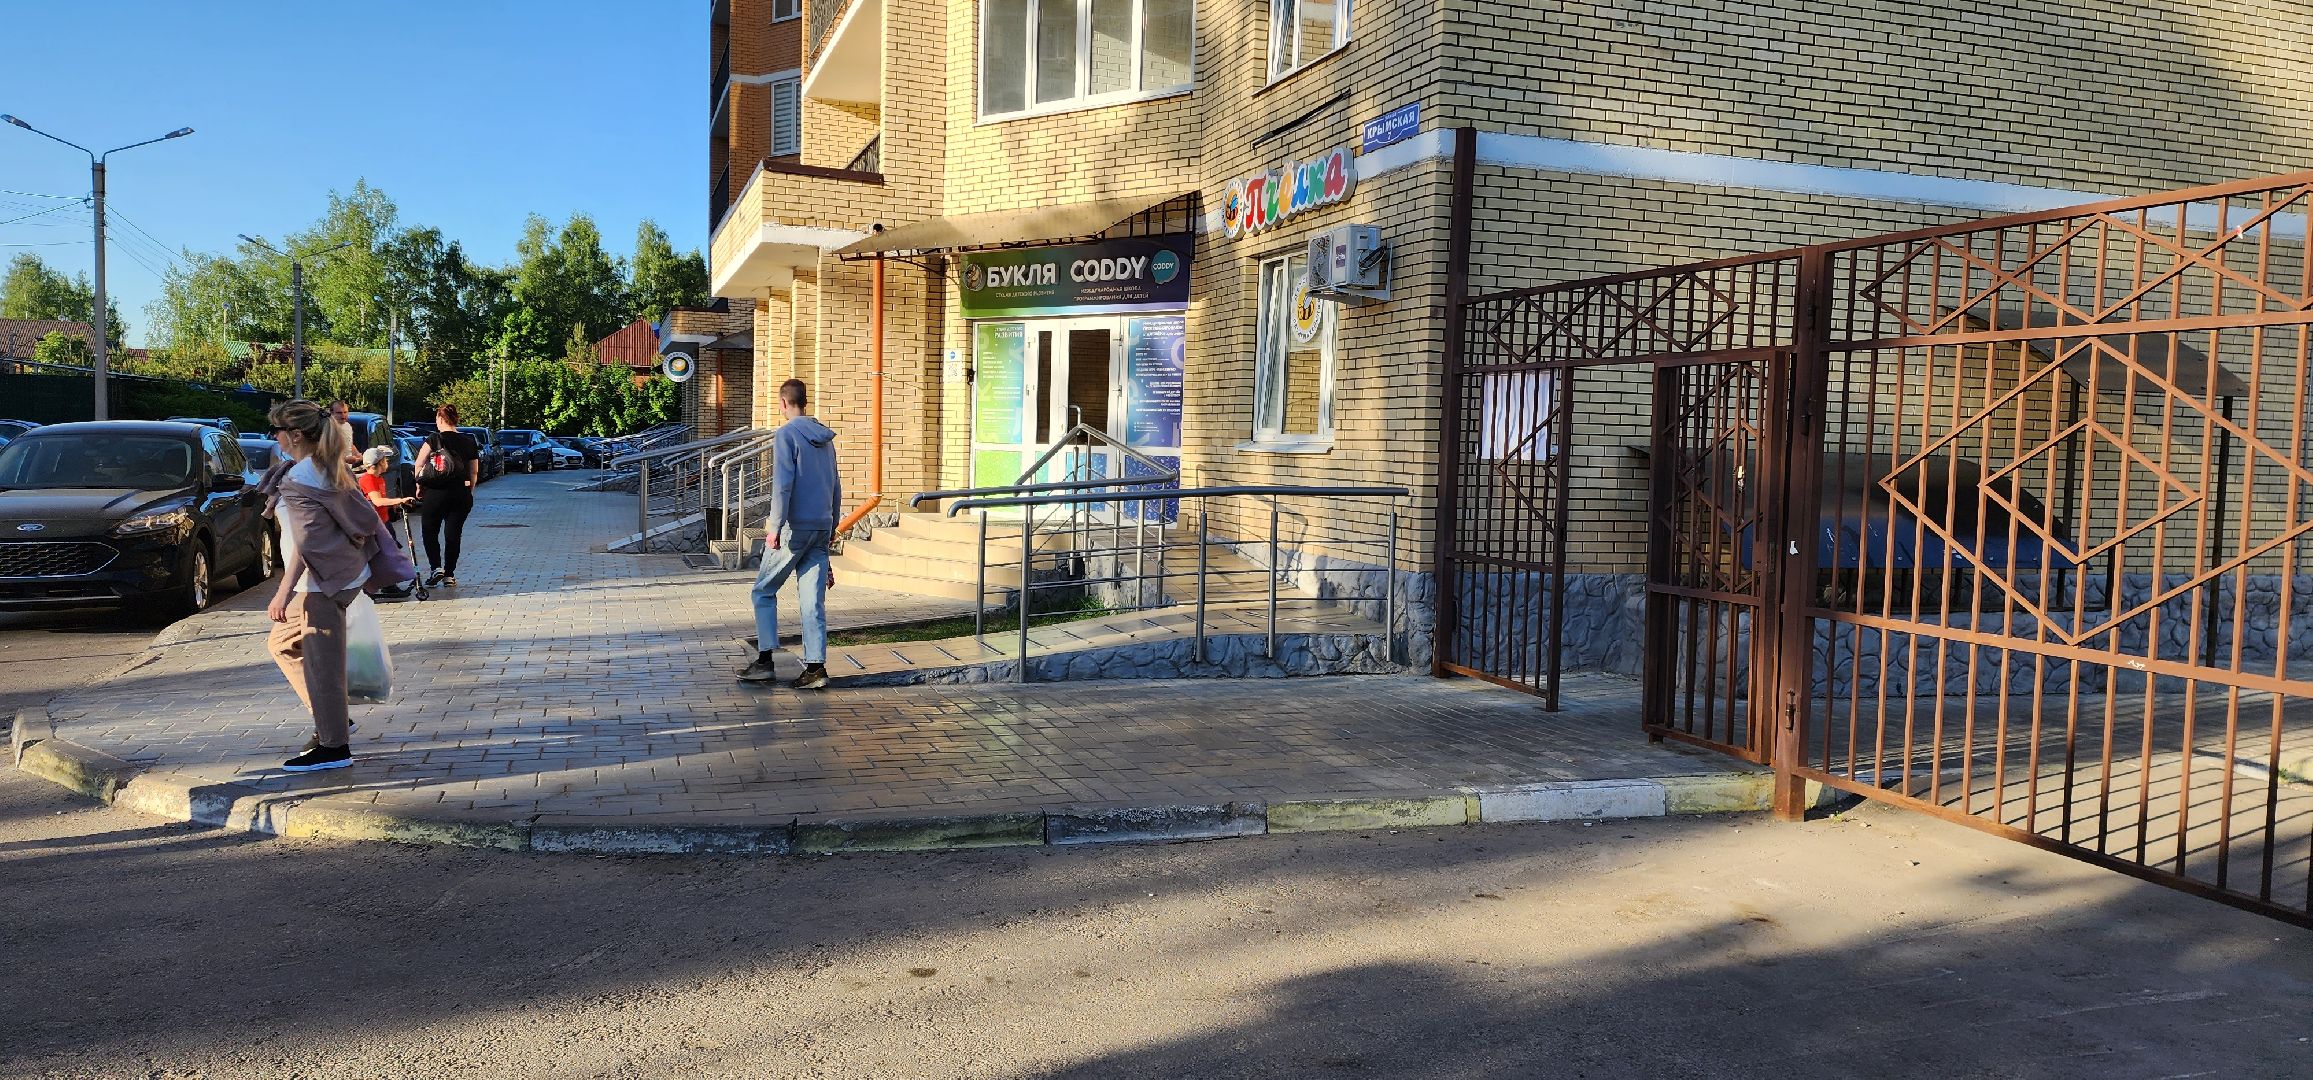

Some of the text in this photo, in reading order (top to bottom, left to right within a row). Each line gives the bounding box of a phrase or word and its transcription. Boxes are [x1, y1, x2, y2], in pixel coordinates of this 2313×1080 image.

[1367, 111, 1415, 139] КРЫМСКАЯ
[987, 262, 1057, 288] БУКЛЯ
[1070, 255, 1147, 283] CODDY
[1152, 262, 1175, 271] CODDY
